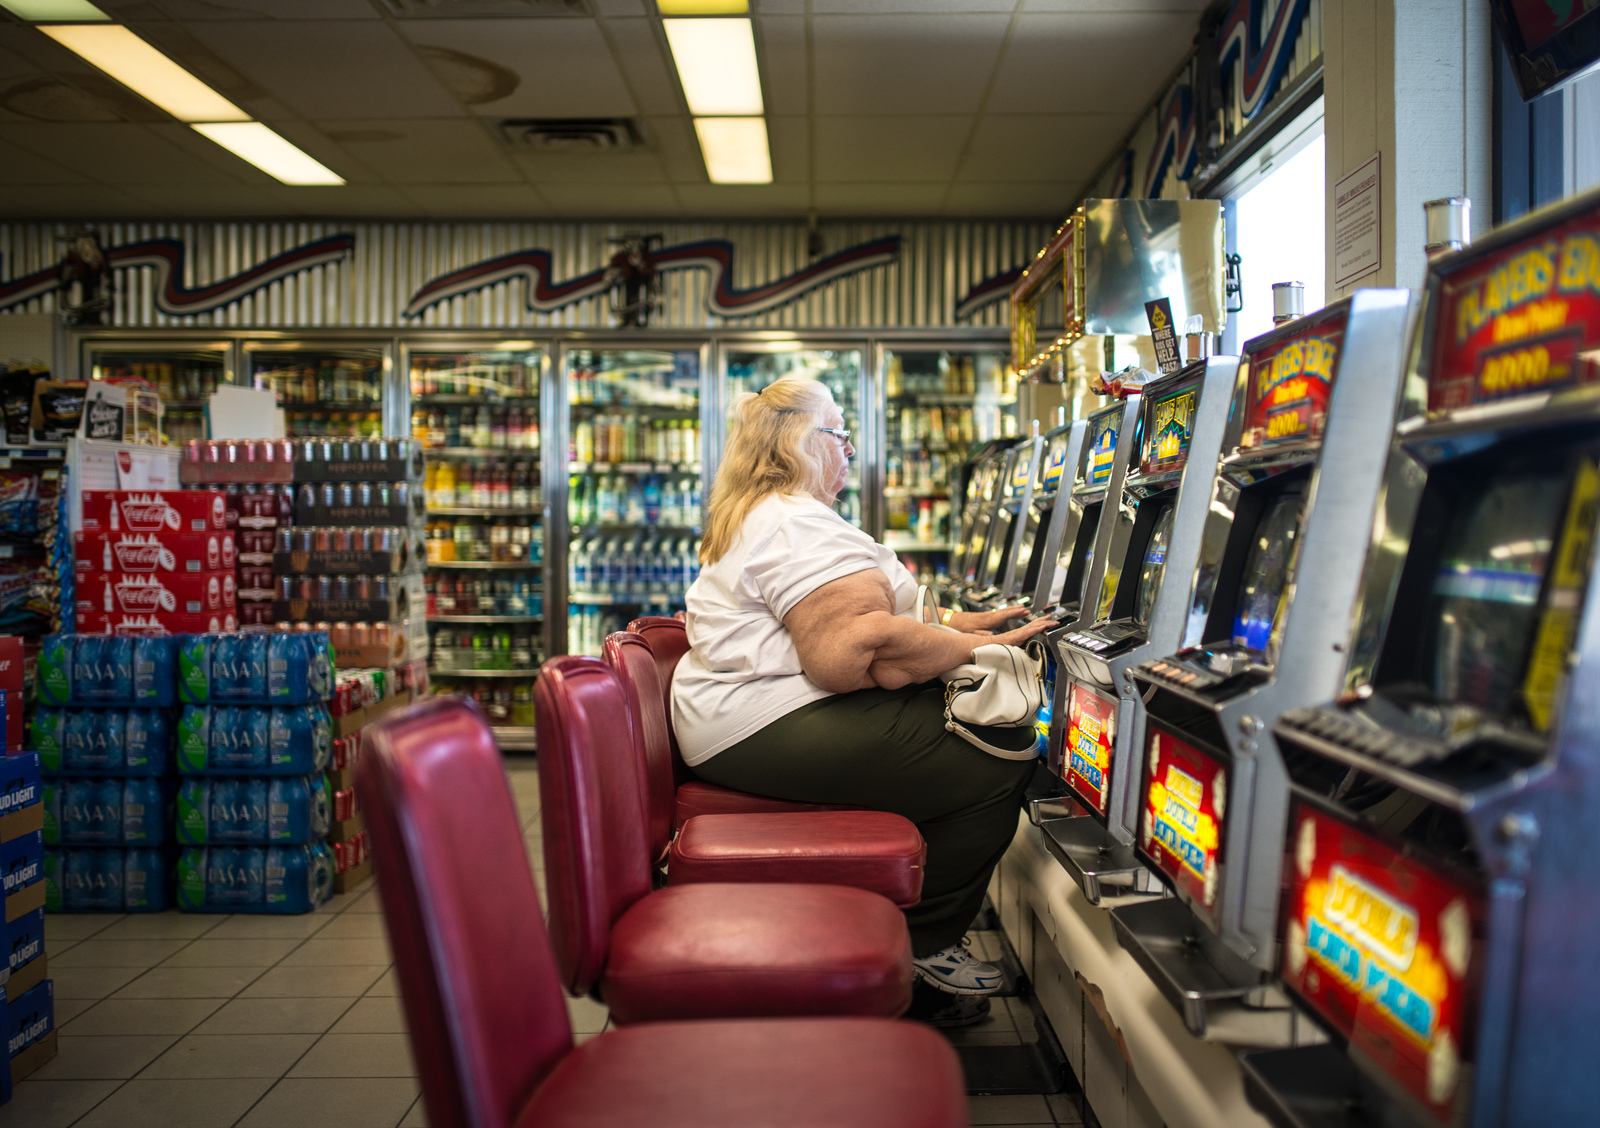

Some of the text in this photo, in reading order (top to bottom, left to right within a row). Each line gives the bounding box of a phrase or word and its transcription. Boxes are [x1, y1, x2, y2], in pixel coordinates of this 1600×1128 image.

[126, 505, 166, 522] Coca-Cola
[119, 546, 160, 563] Coca-Cola
[119, 587, 160, 604] Coca-Cola
[74, 659, 132, 682] DASANI
[211, 658, 266, 681] DASANI
[0, 786, 35, 810] UD LIGHT
[3, 863, 38, 890] UD LIGHT
[17, 940, 39, 962] LIGHT
[25, 1016, 48, 1041] LIGHT
